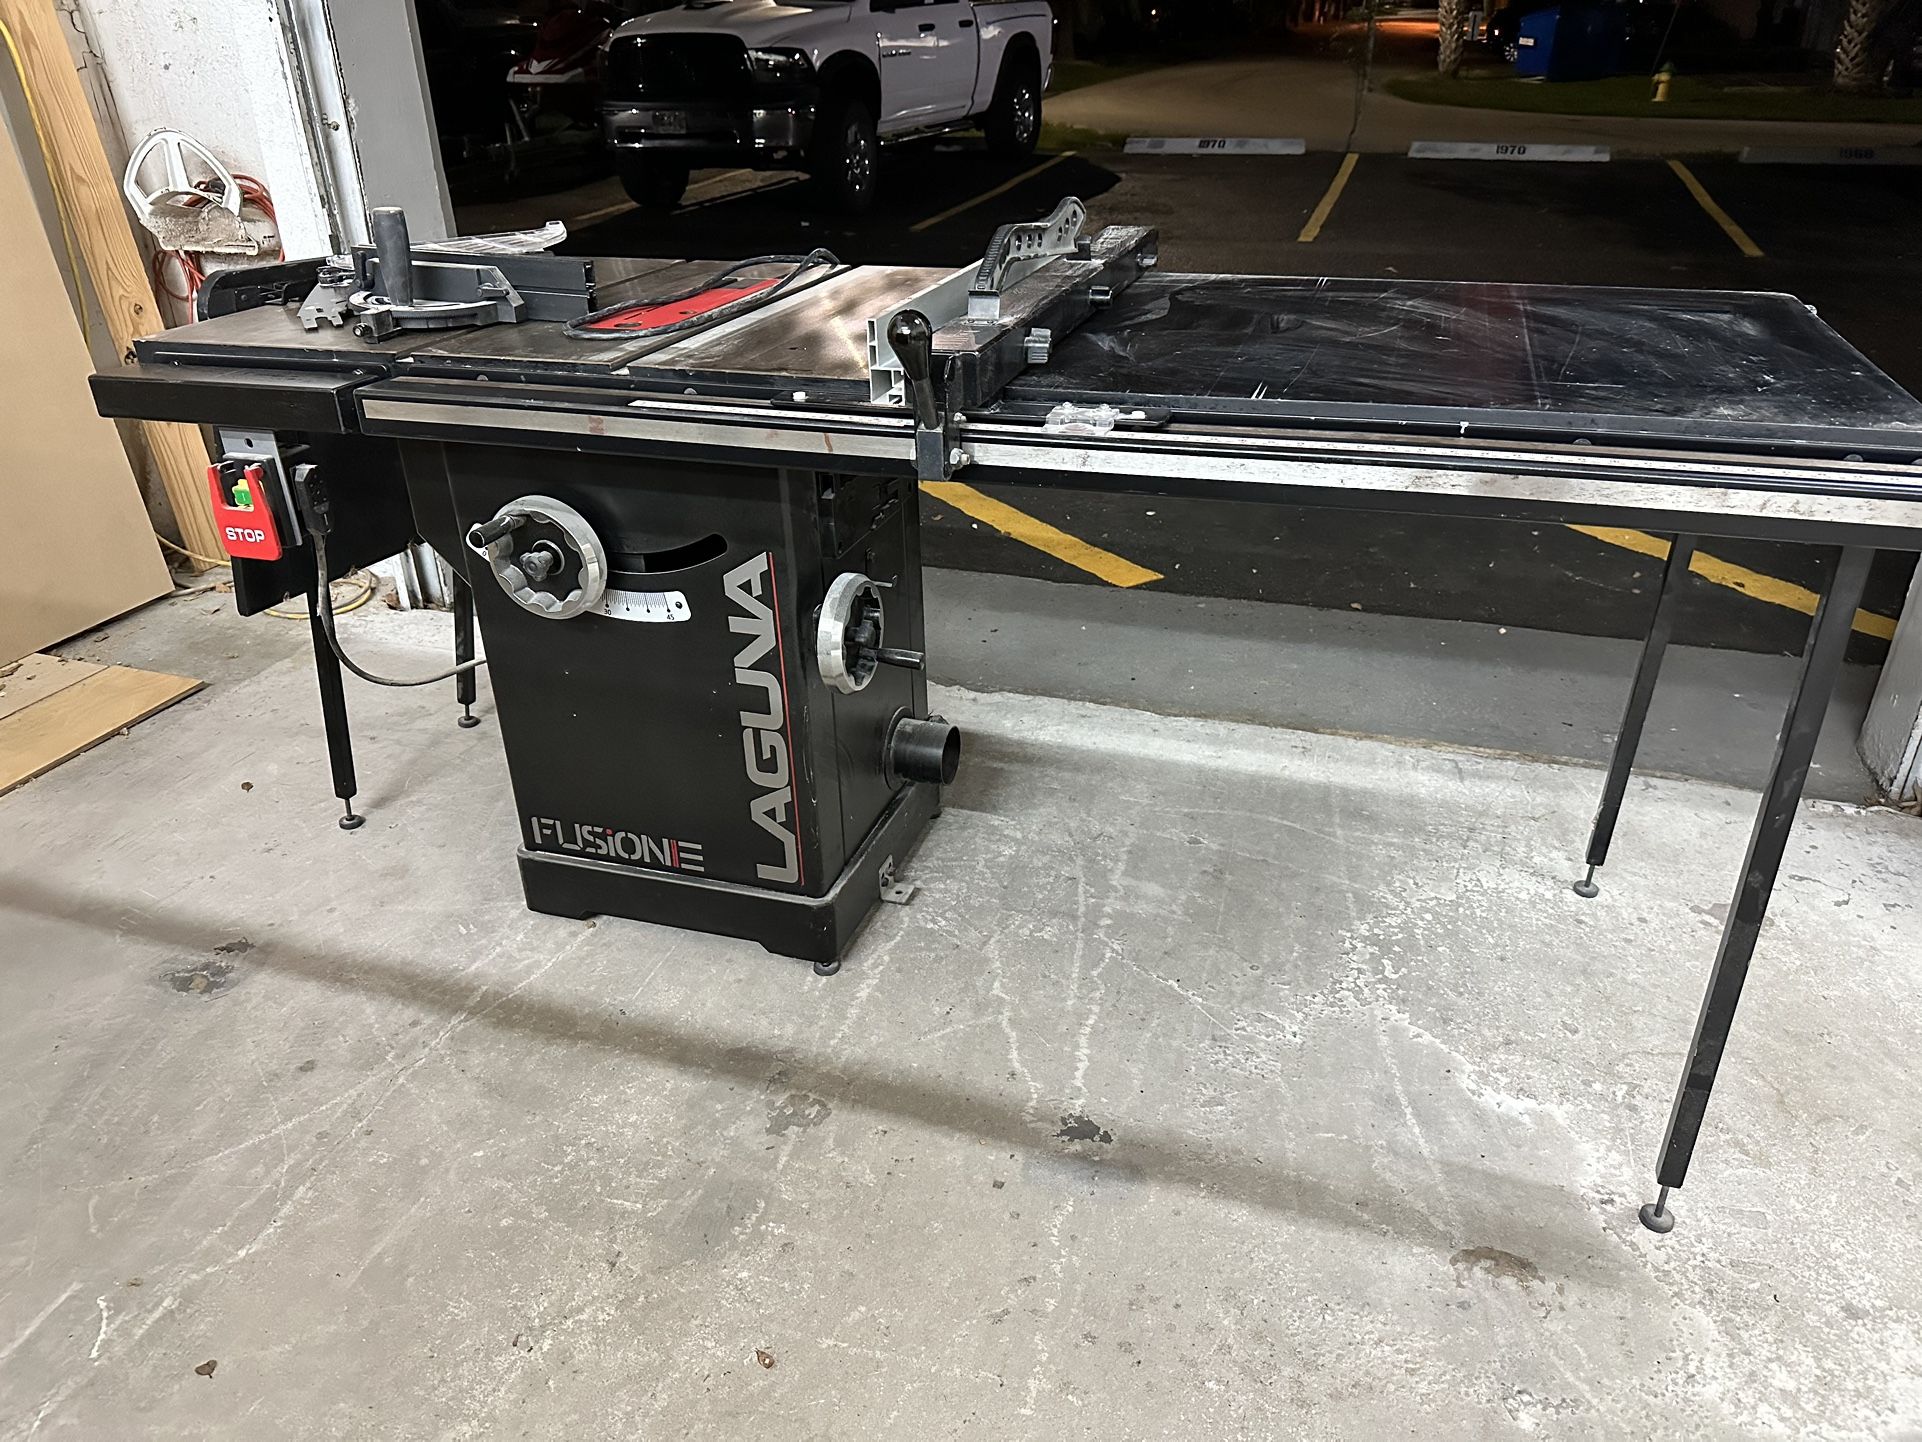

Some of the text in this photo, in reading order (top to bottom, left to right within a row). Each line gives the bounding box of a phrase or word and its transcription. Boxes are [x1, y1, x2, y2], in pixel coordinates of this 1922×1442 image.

[1495, 144, 1527, 156] 1970
[225, 527, 265, 543] STOP
[603, 608, 612, 616] 30
[666, 613, 675, 621] 45
[723, 551, 799, 884] LAGUNA
